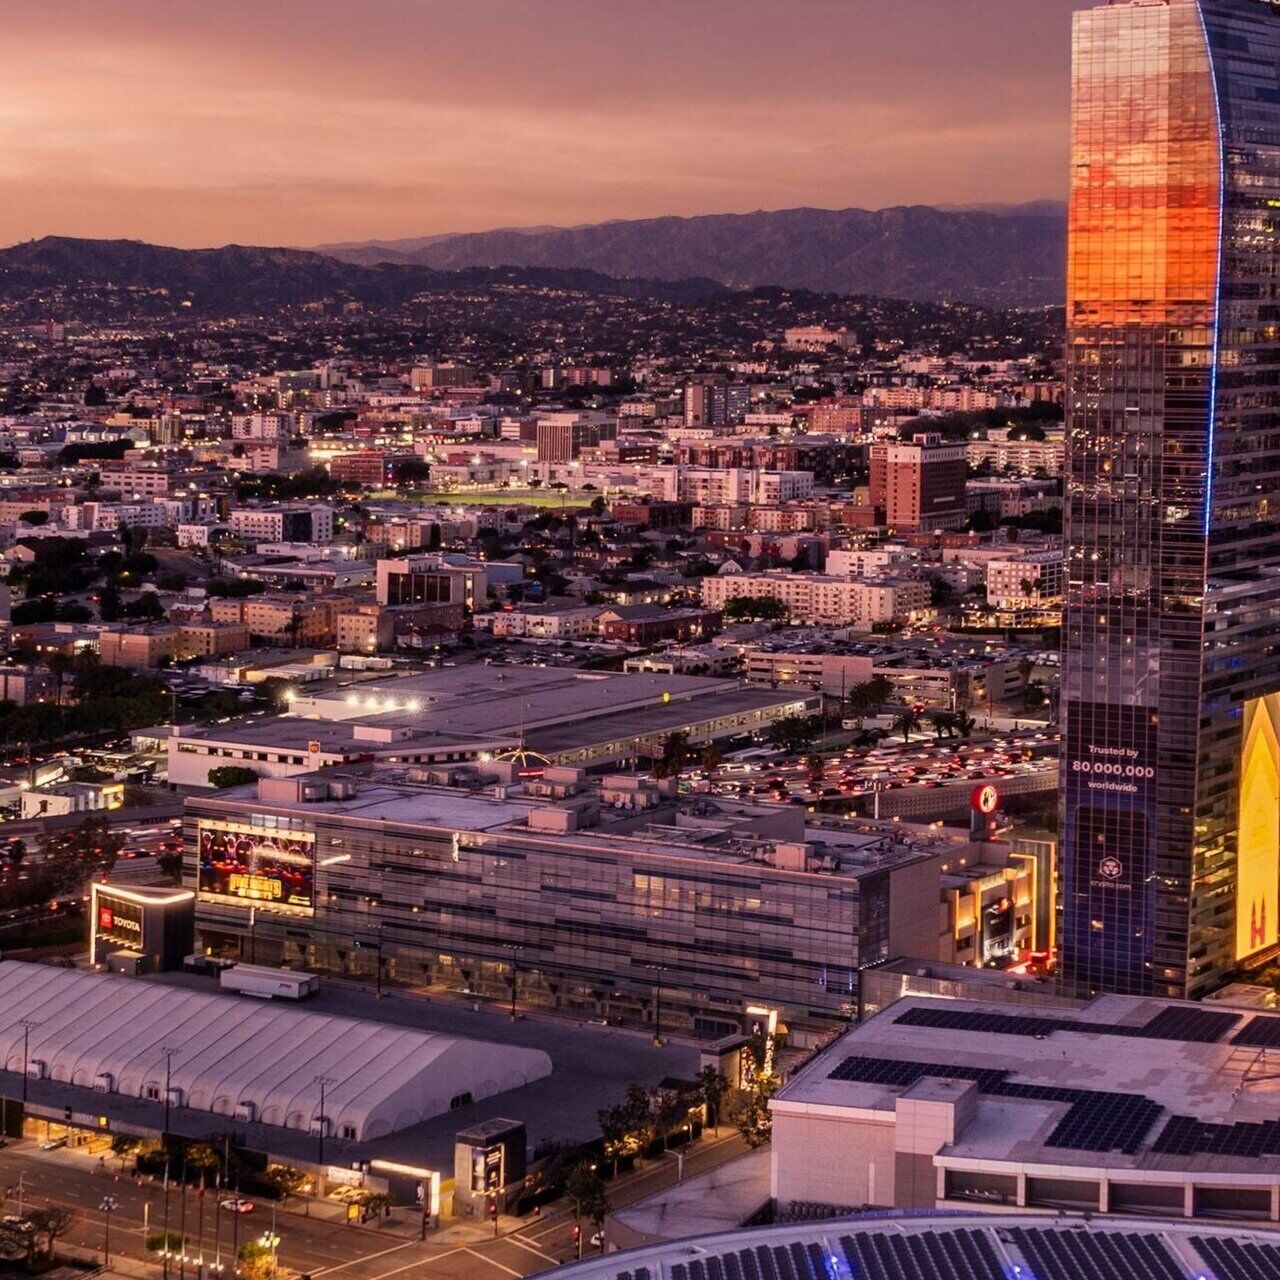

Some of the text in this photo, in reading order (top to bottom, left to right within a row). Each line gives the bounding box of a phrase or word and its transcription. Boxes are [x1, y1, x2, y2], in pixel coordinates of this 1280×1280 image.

[1088, 744, 1139, 759] Trusted by
[1072, 760, 1154, 778] 80,000,000
[1087, 781, 1138, 792] worldwide
[113, 916, 141, 932] TOYOTA
